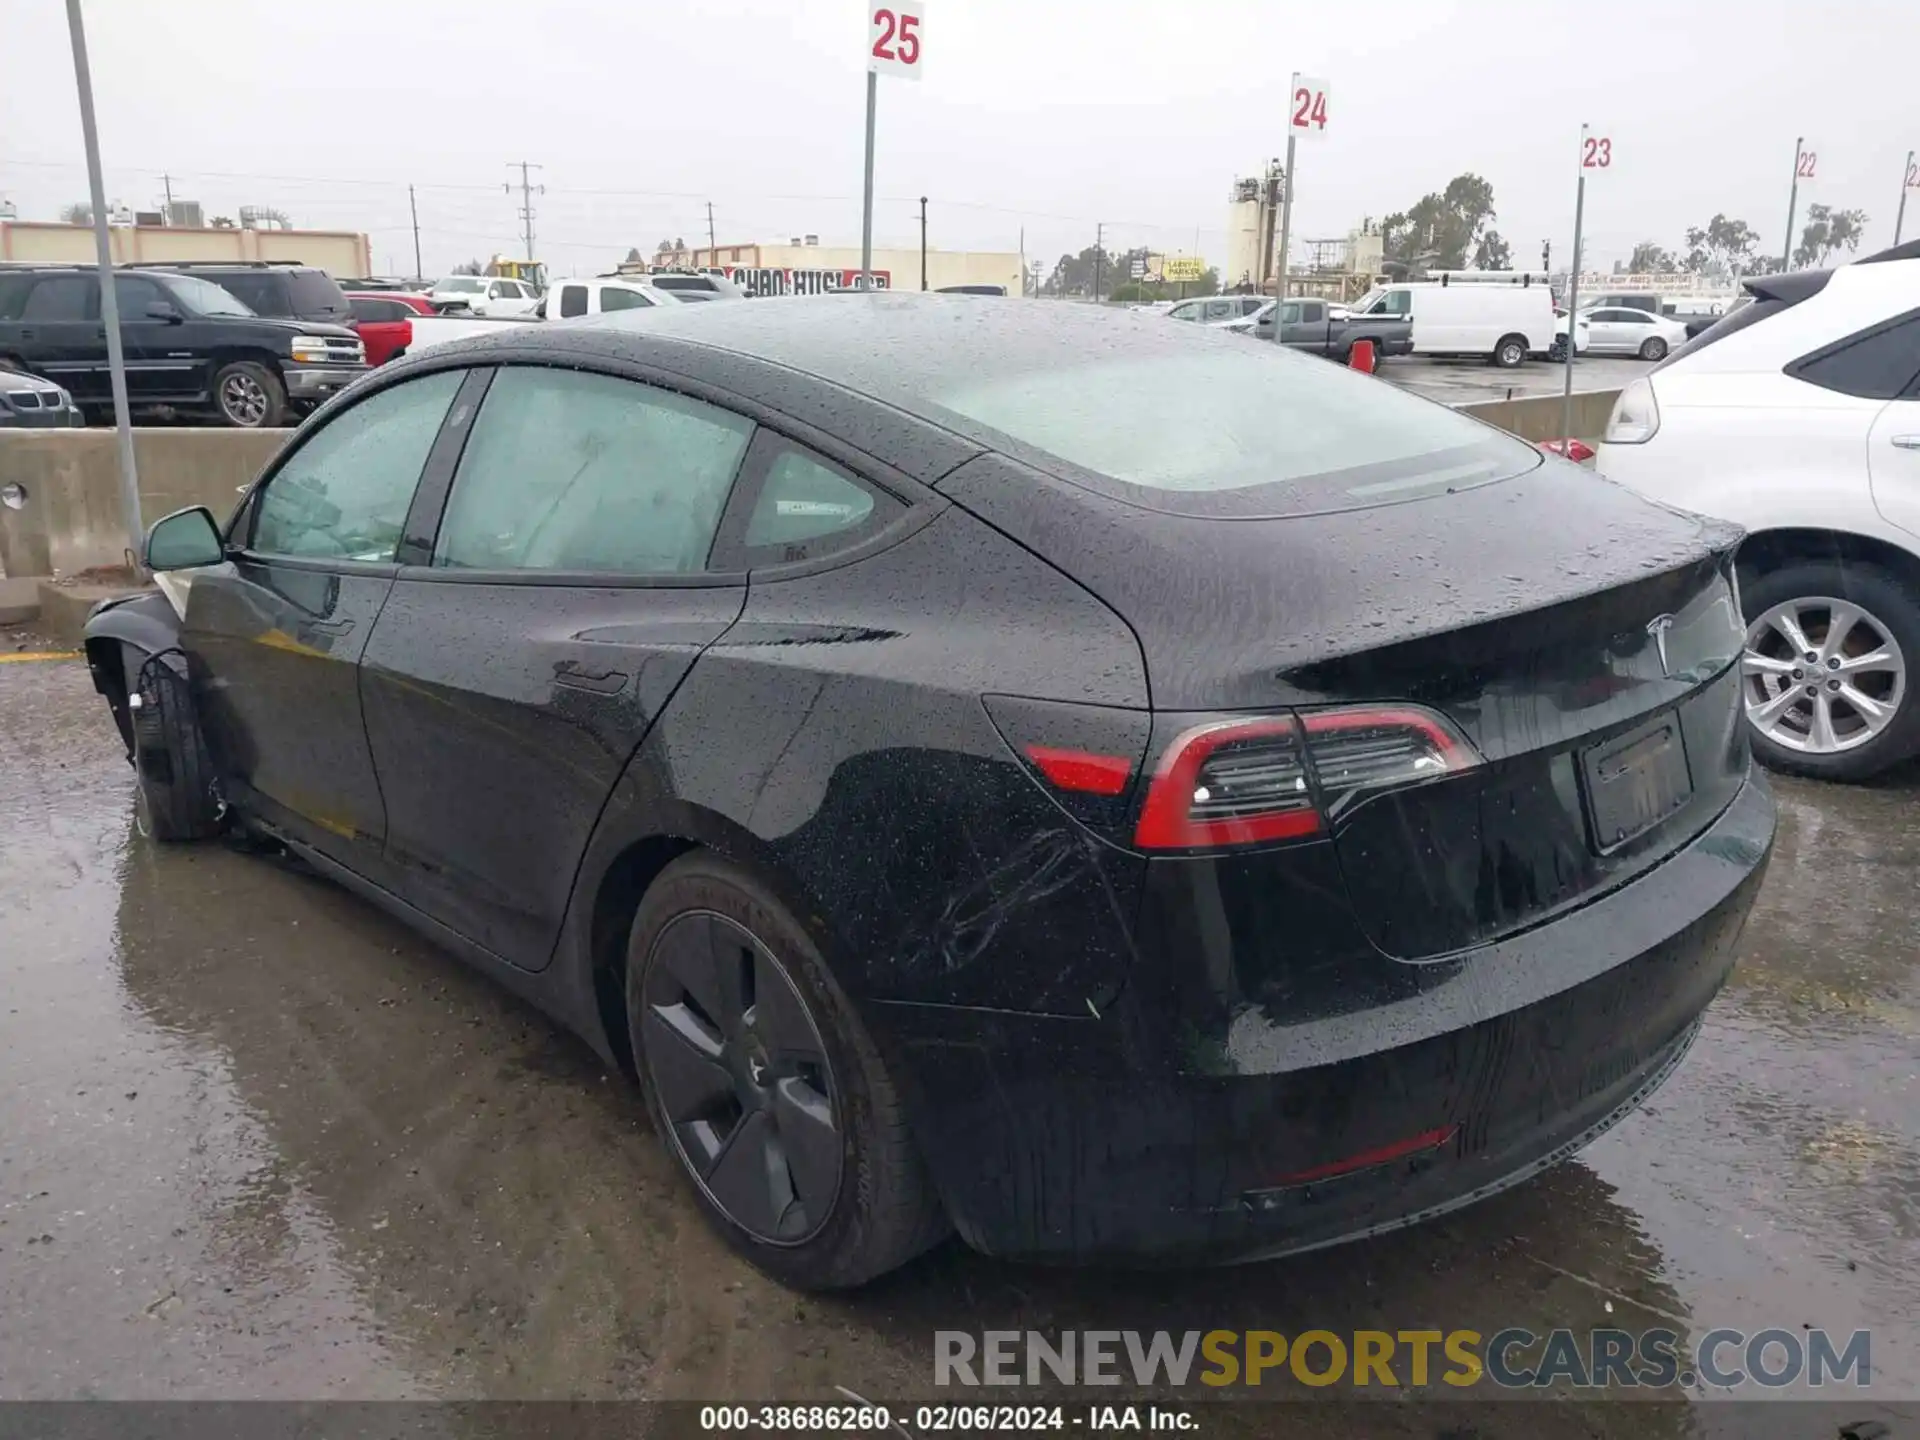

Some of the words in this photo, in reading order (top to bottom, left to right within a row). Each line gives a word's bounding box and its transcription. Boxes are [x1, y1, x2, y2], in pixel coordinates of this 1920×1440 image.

[872, 8, 920, 64] 25
[1293, 87, 1327, 130] 24
[1583, 137, 1611, 167] 23
[1798, 151, 1817, 178] 22
[1907, 163, 1920, 187] 2
[1168, 268, 1200, 276] PARKER
